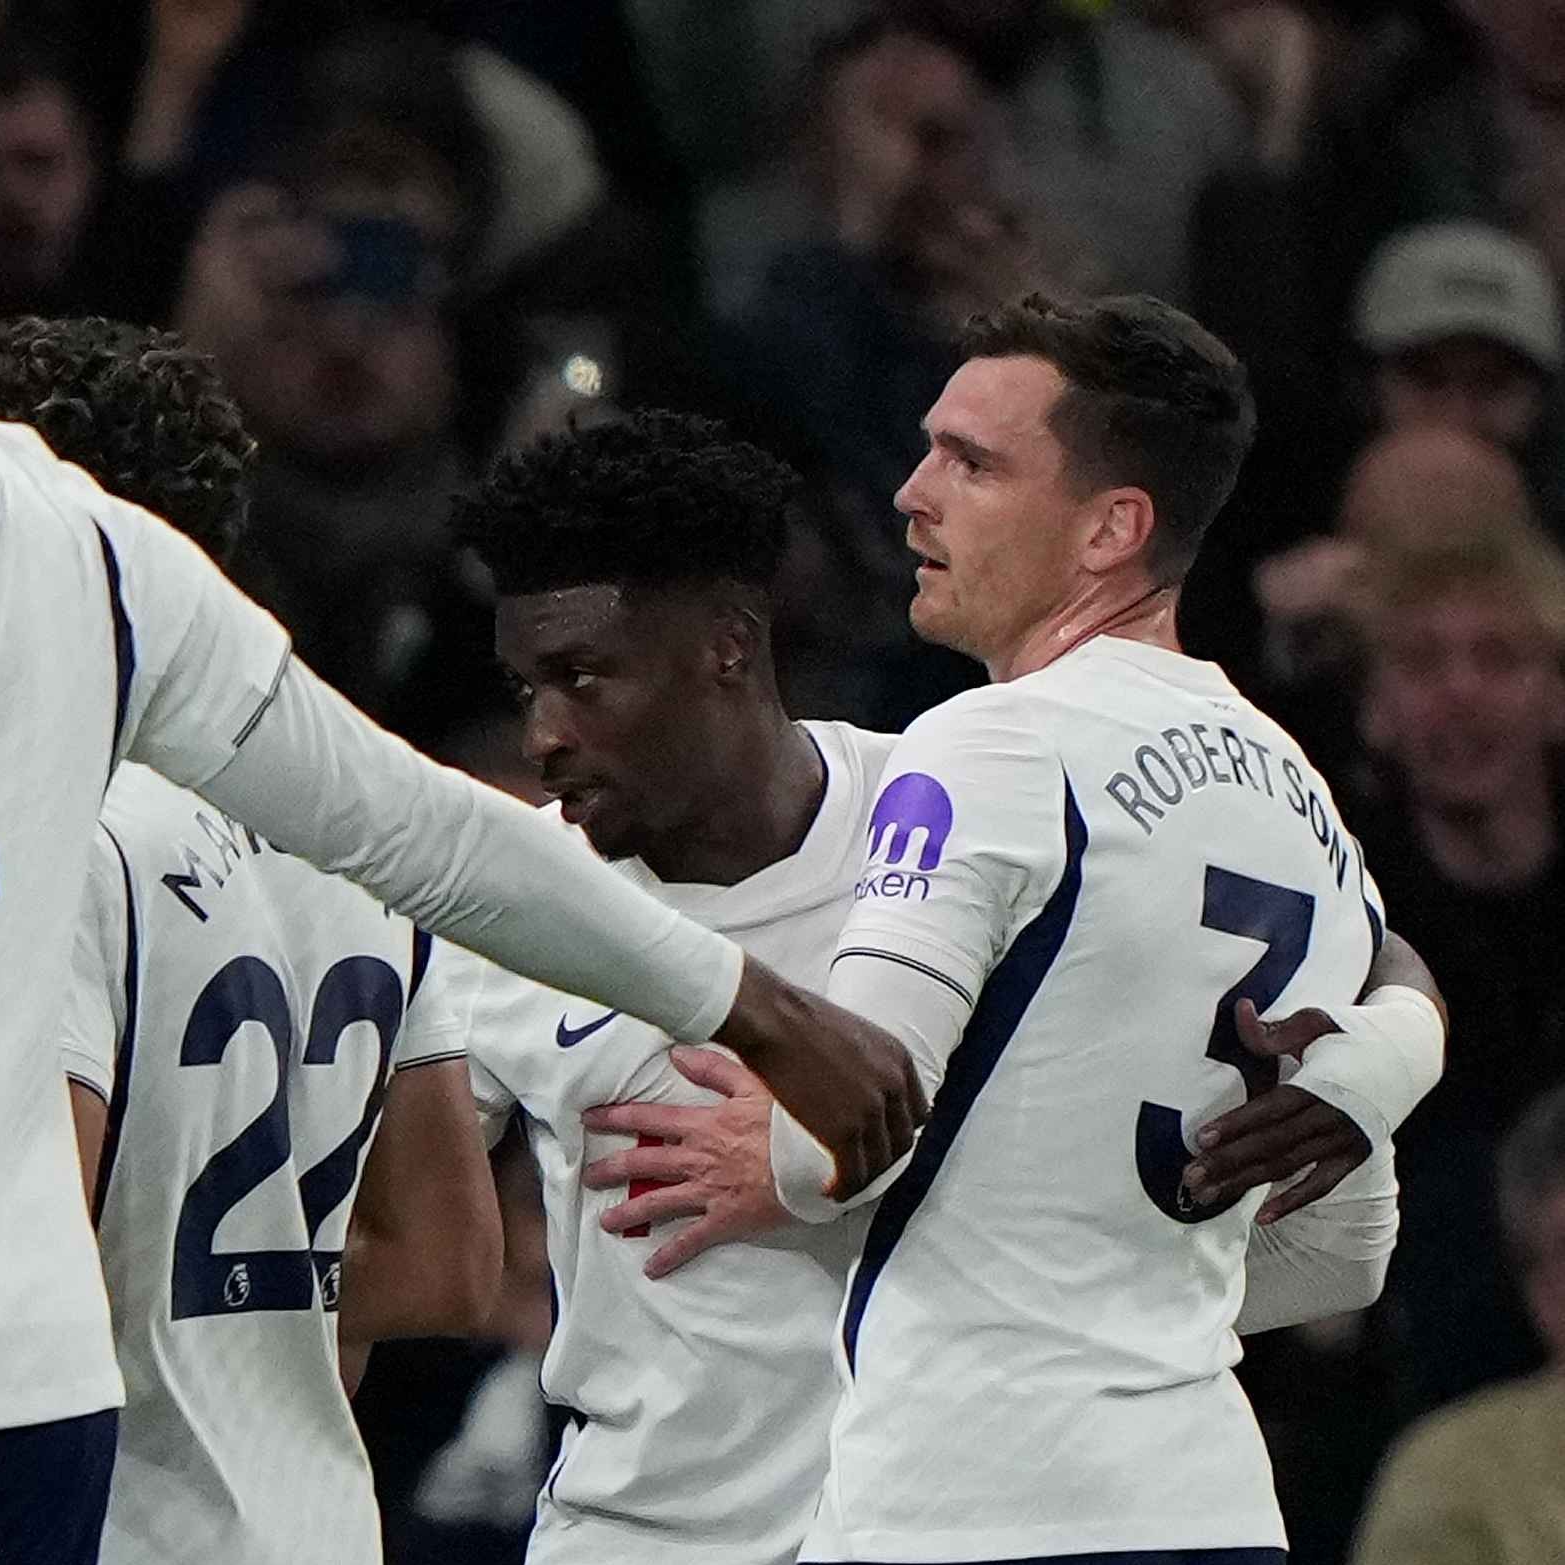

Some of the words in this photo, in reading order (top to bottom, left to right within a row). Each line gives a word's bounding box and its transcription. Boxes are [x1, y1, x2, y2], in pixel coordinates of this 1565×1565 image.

[1104, 723, 1348, 892] ROBERTSON
[170, 955, 406, 1321] 22
[1135, 864, 1316, 1225] 3
